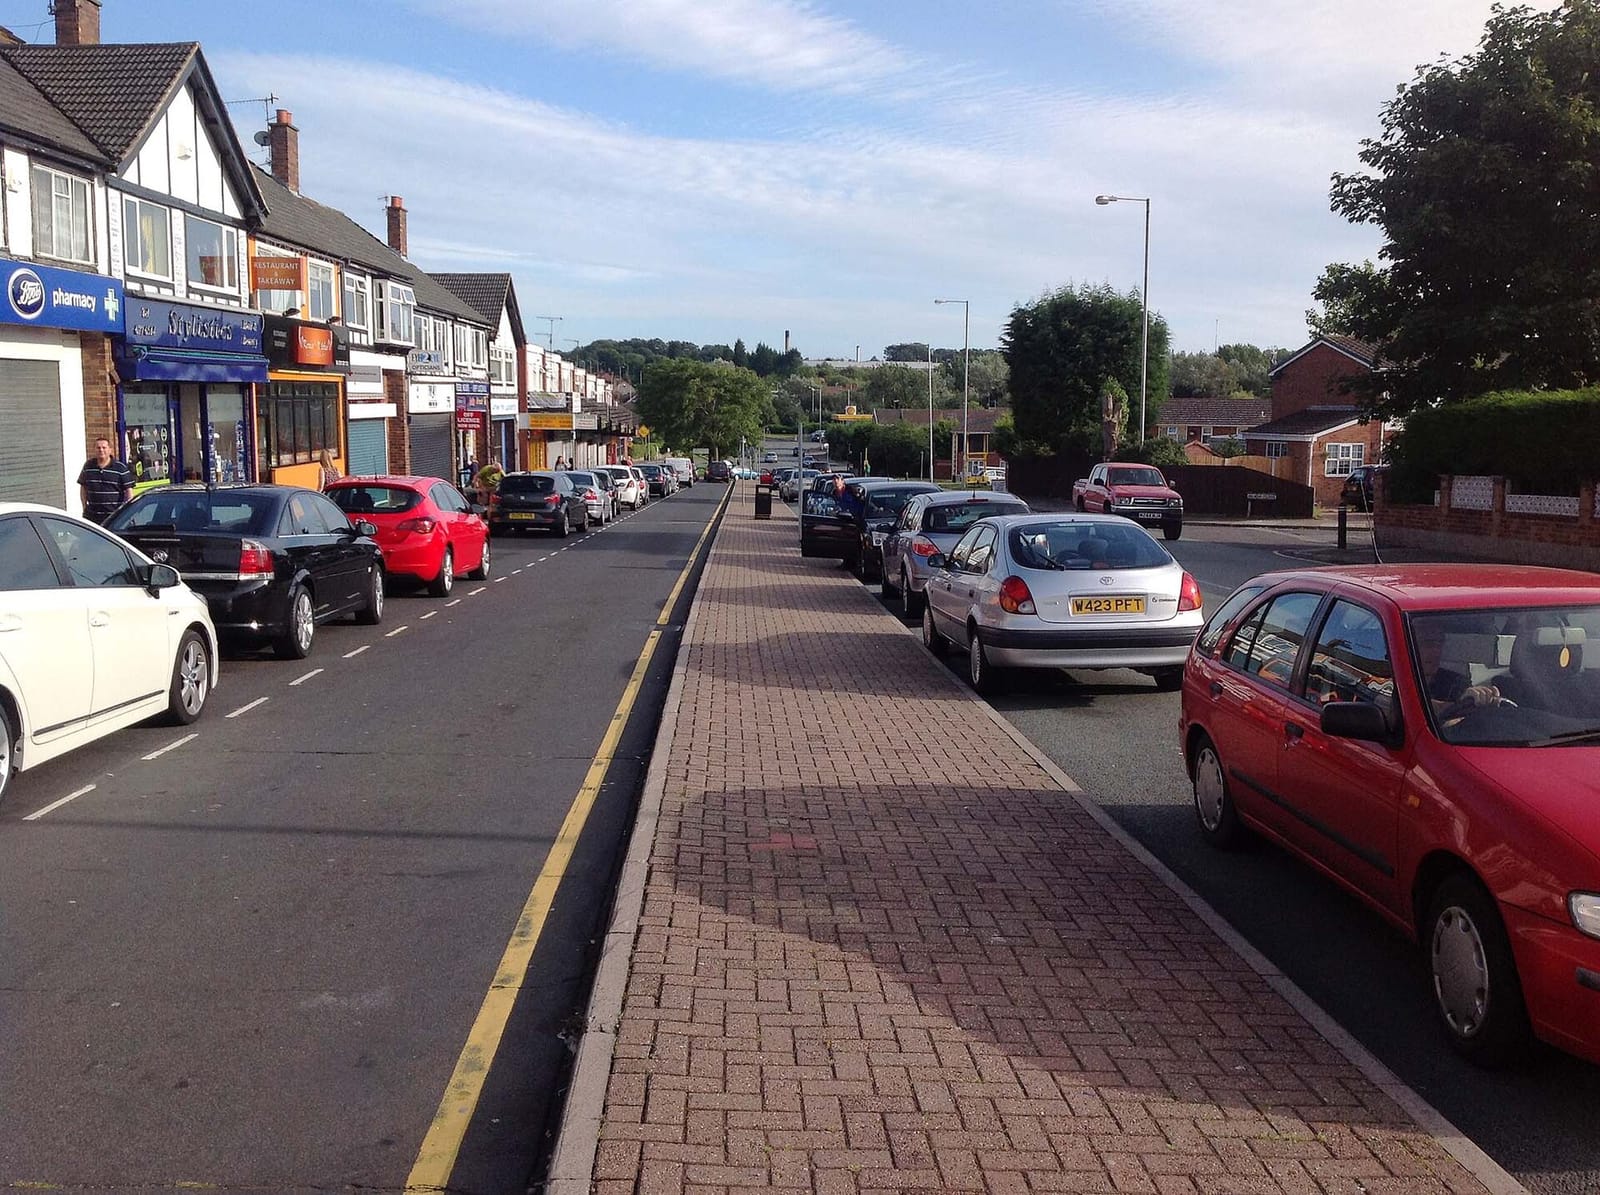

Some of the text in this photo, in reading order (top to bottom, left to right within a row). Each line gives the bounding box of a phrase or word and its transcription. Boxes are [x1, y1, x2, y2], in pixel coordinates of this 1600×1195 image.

[256, 262, 299, 270] RESTAURANT
[258, 277, 296, 285] TAKEAWAY
[53, 288, 96, 312] pharmacy
[1075, 599, 1142, 611] W423 PFT
